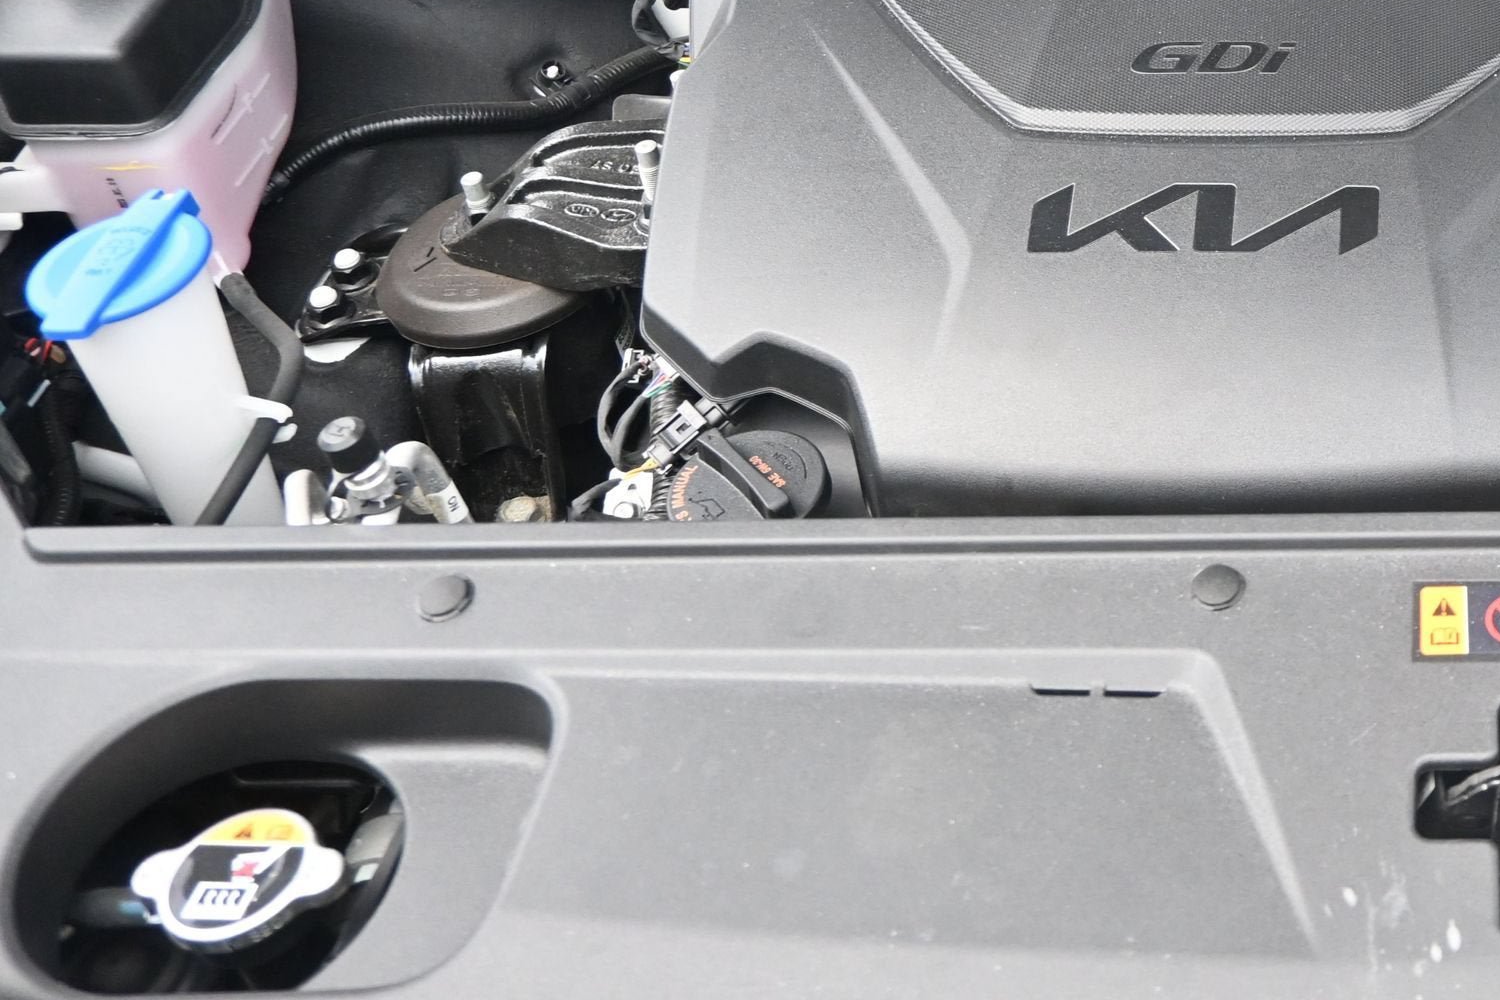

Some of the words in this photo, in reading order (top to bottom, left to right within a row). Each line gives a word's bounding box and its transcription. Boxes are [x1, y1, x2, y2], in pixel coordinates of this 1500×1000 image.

[1131, 40, 1297, 75] GDi
[1027, 182, 1381, 256] KIA
[671, 464, 699, 510] MANUAL
[767, 471, 787, 488] SAE
